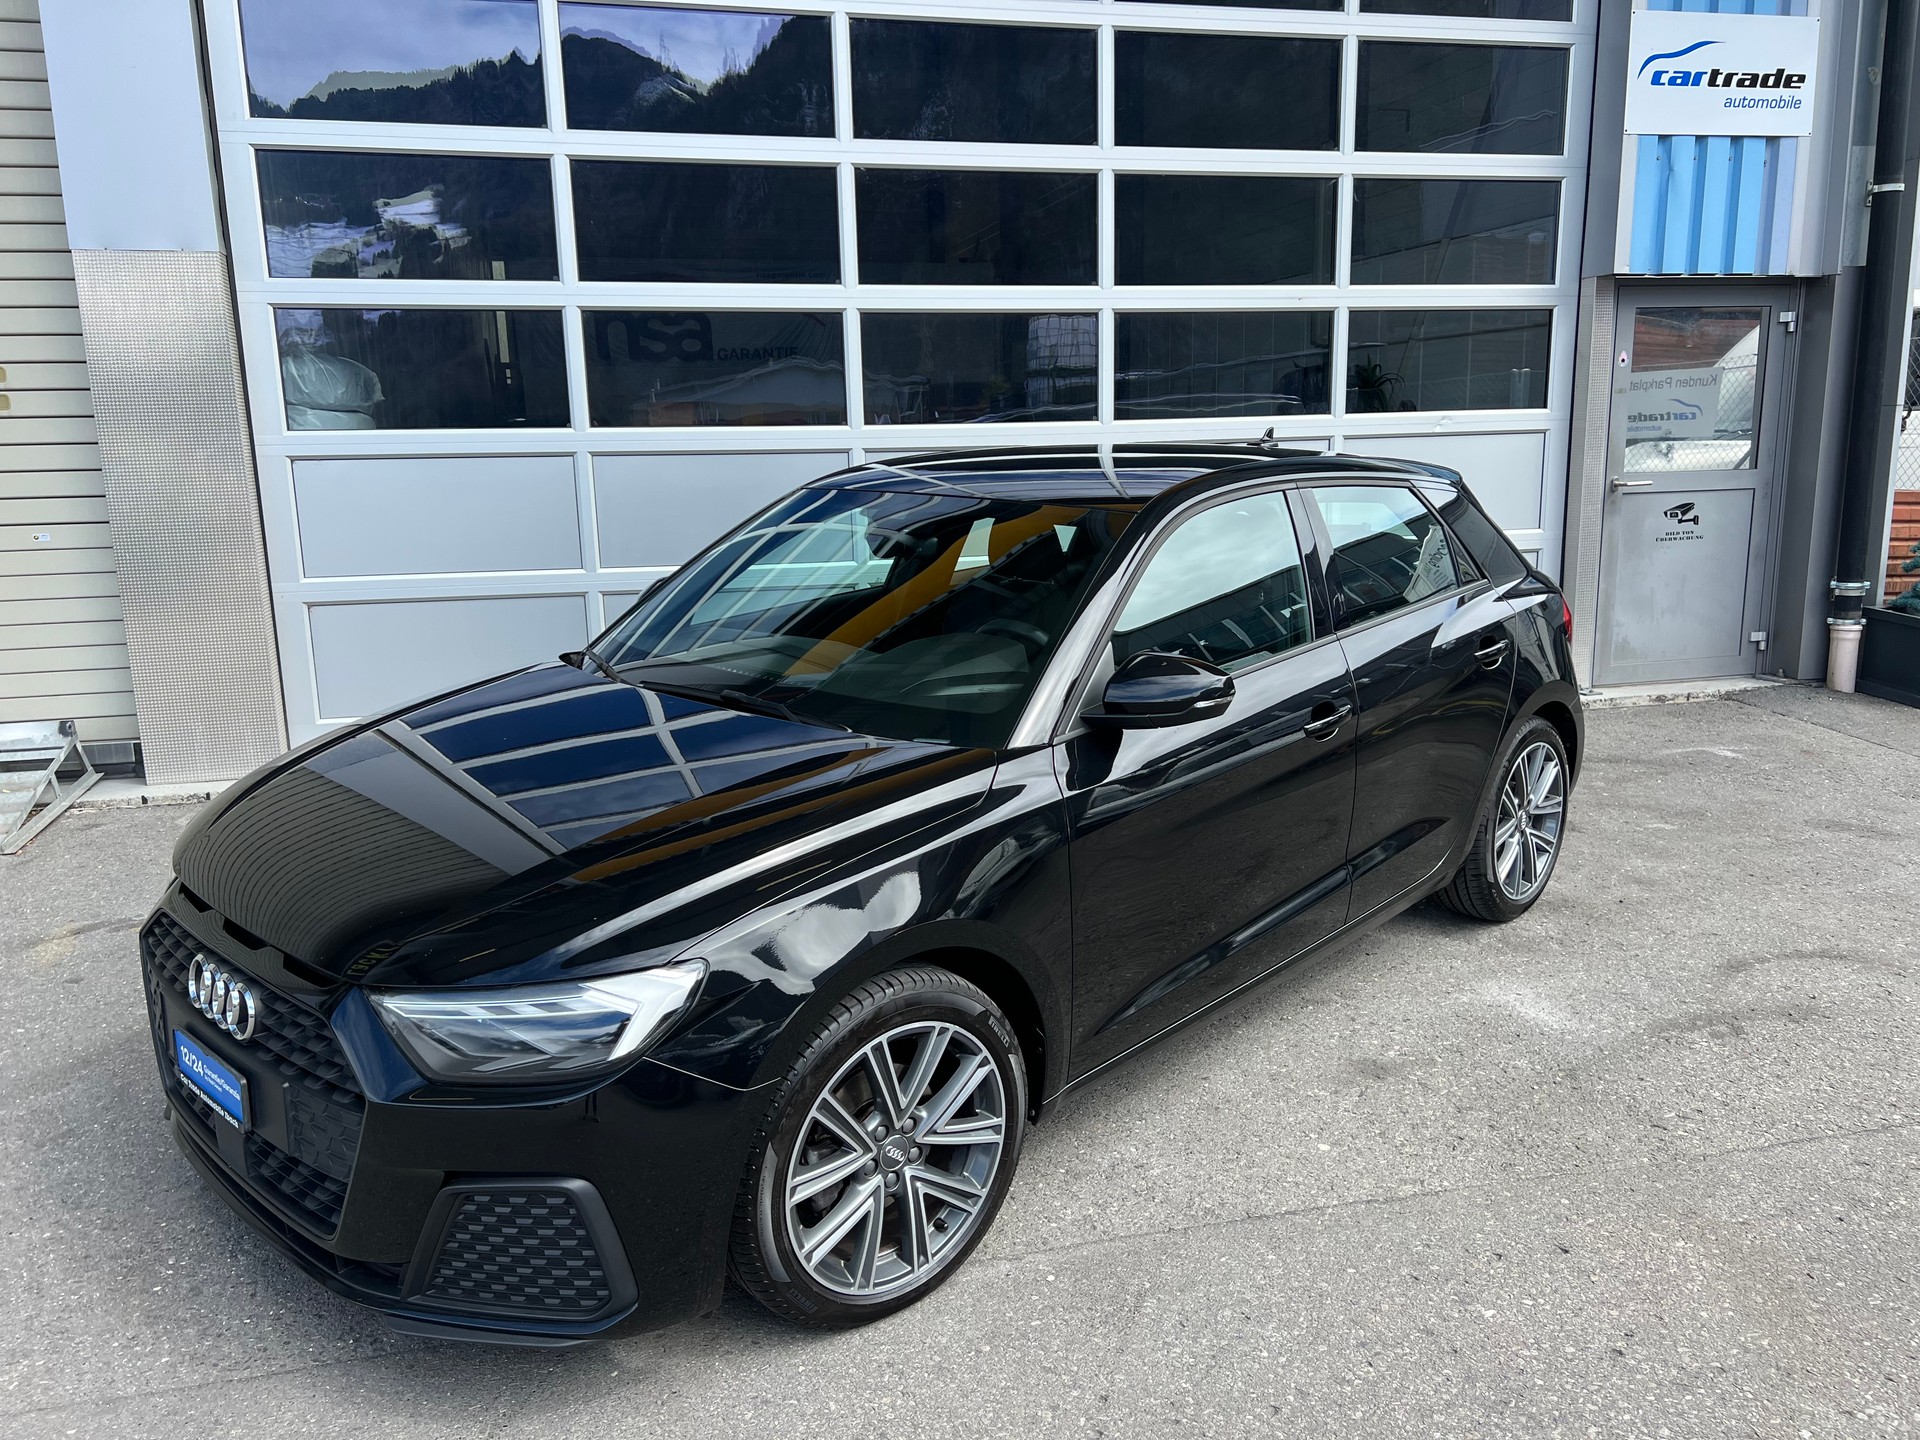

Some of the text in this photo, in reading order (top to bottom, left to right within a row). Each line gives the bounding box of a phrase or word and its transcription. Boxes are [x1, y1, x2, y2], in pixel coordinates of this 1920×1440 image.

[1650, 68, 1806, 90] cartrade
[1723, 94, 1802, 110] automobile
[717, 346, 799, 361] GARANTIE
